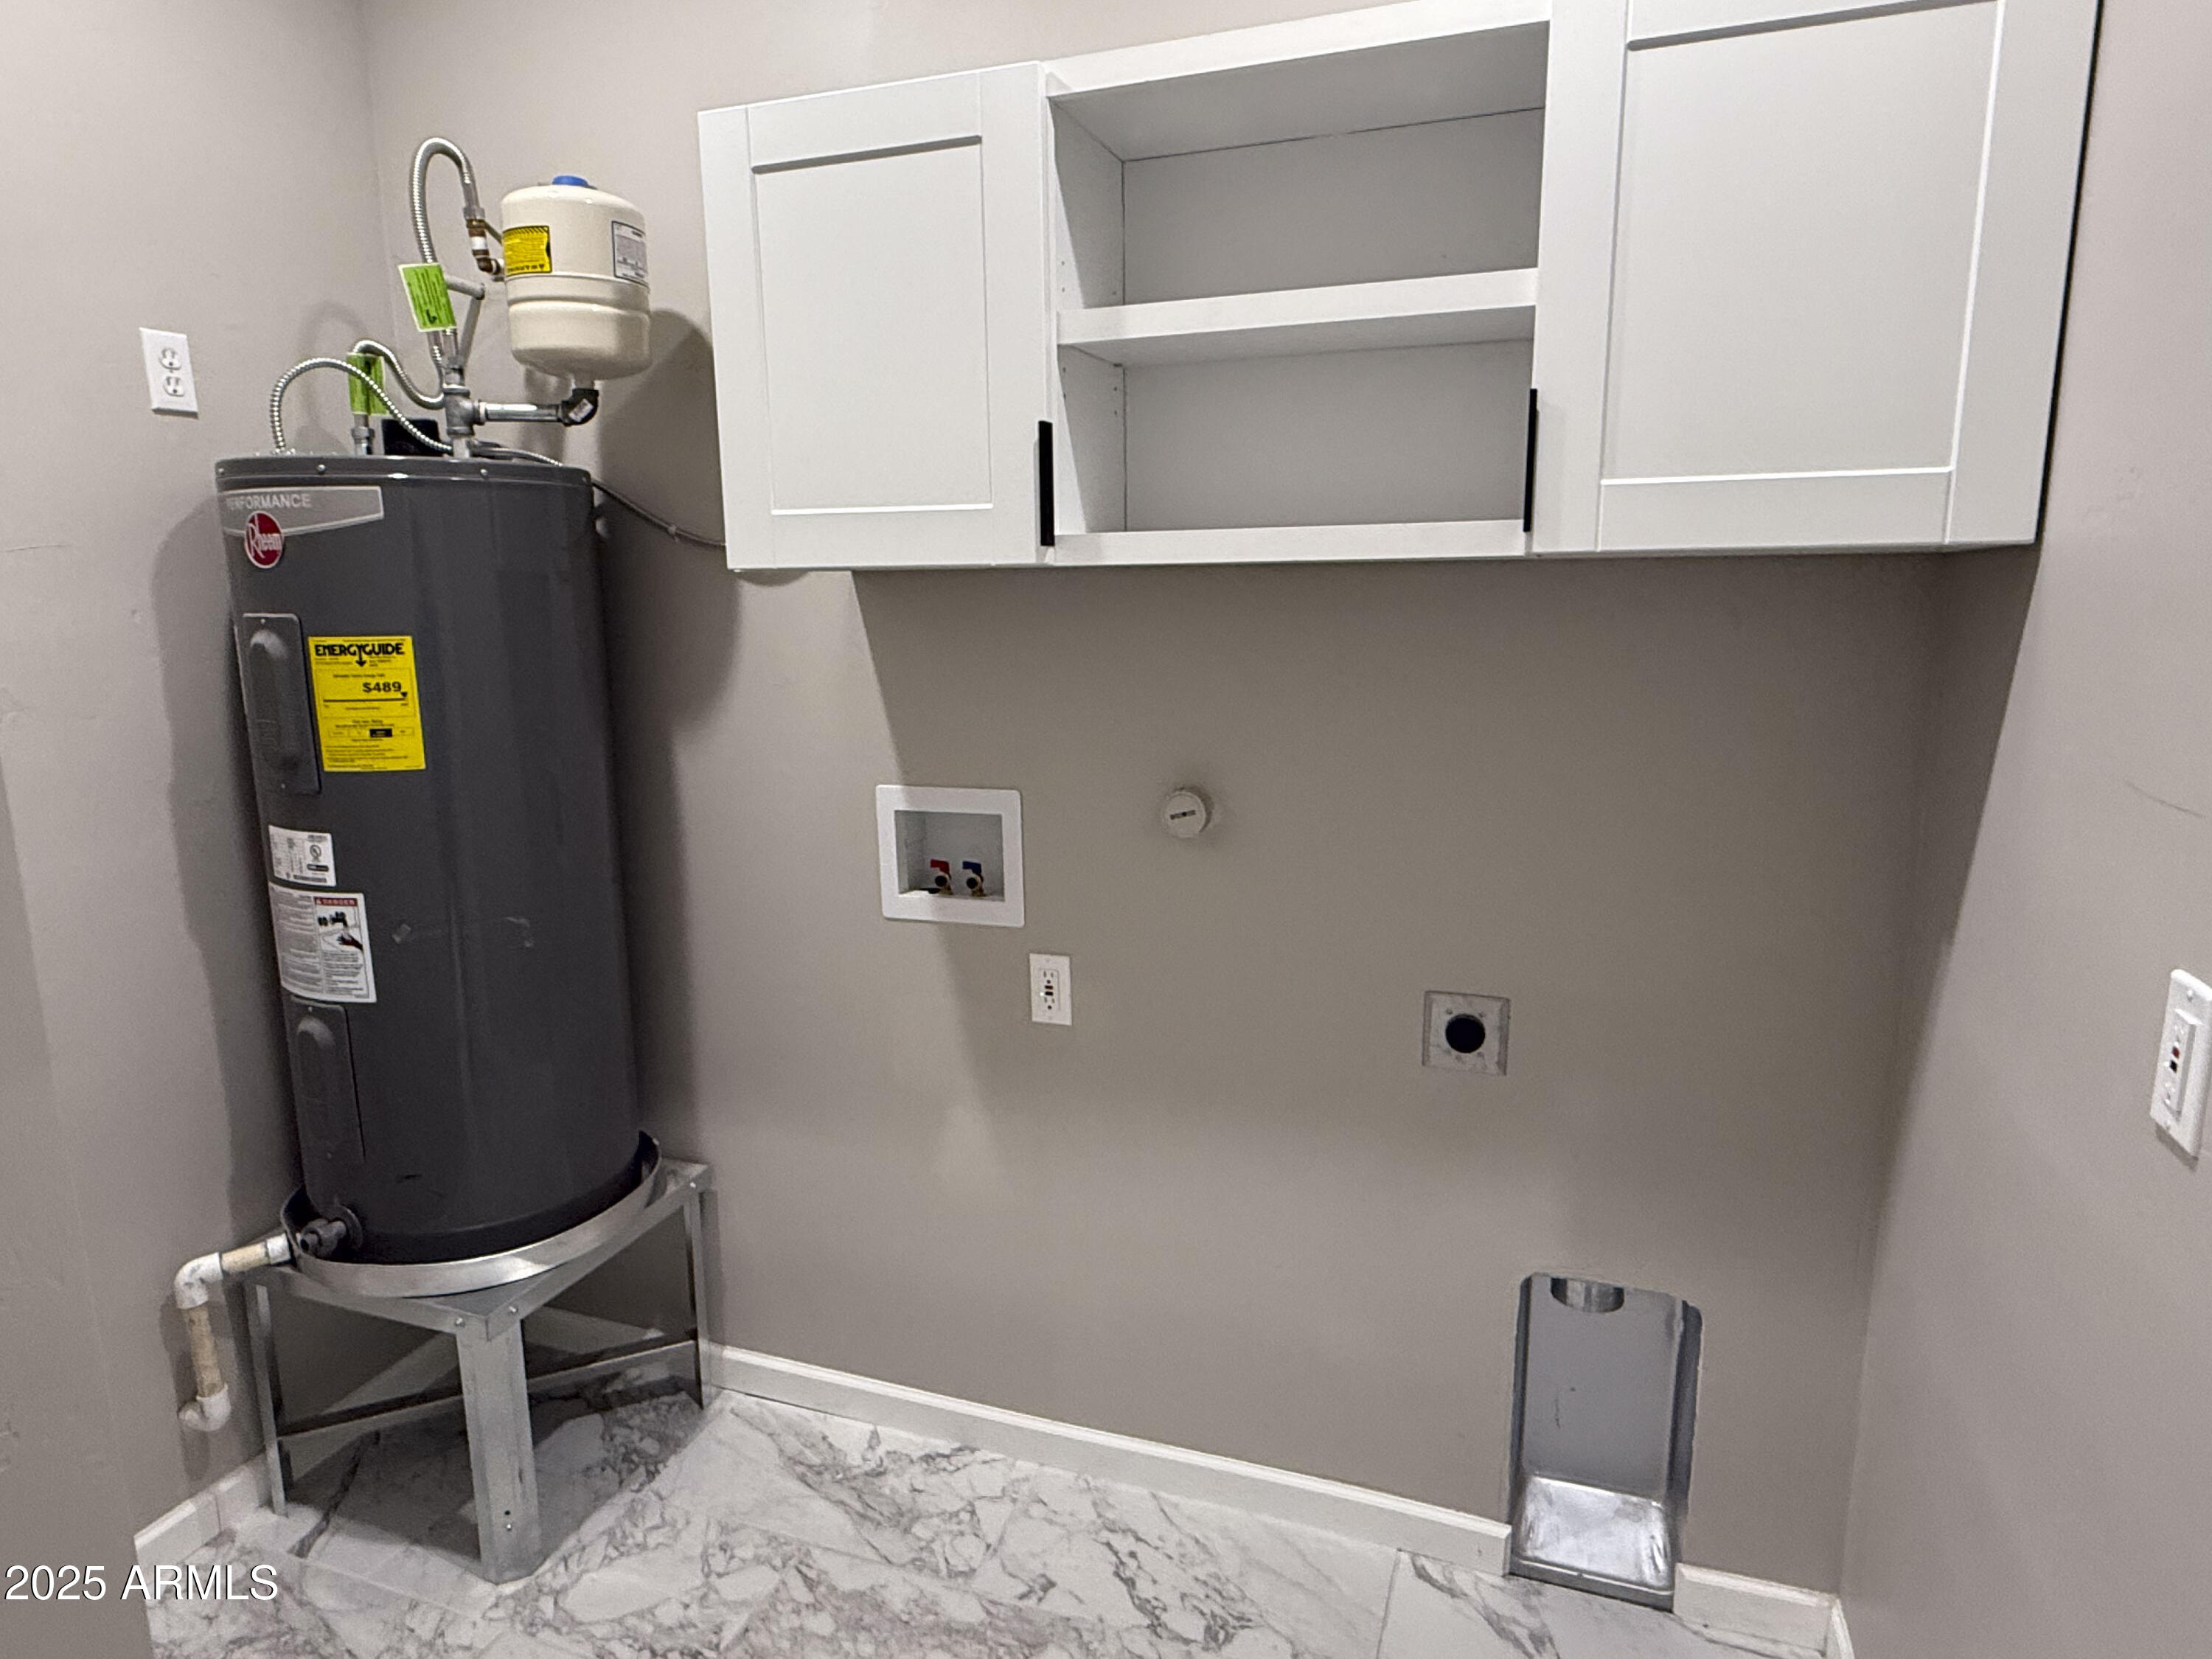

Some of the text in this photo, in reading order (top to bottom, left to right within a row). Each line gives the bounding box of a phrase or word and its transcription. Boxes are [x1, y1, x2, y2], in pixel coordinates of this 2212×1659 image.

[226, 493, 312, 510] PERFORMANCE
[247, 514, 282, 558] Rheem
[363, 681, 402, 693] $489
